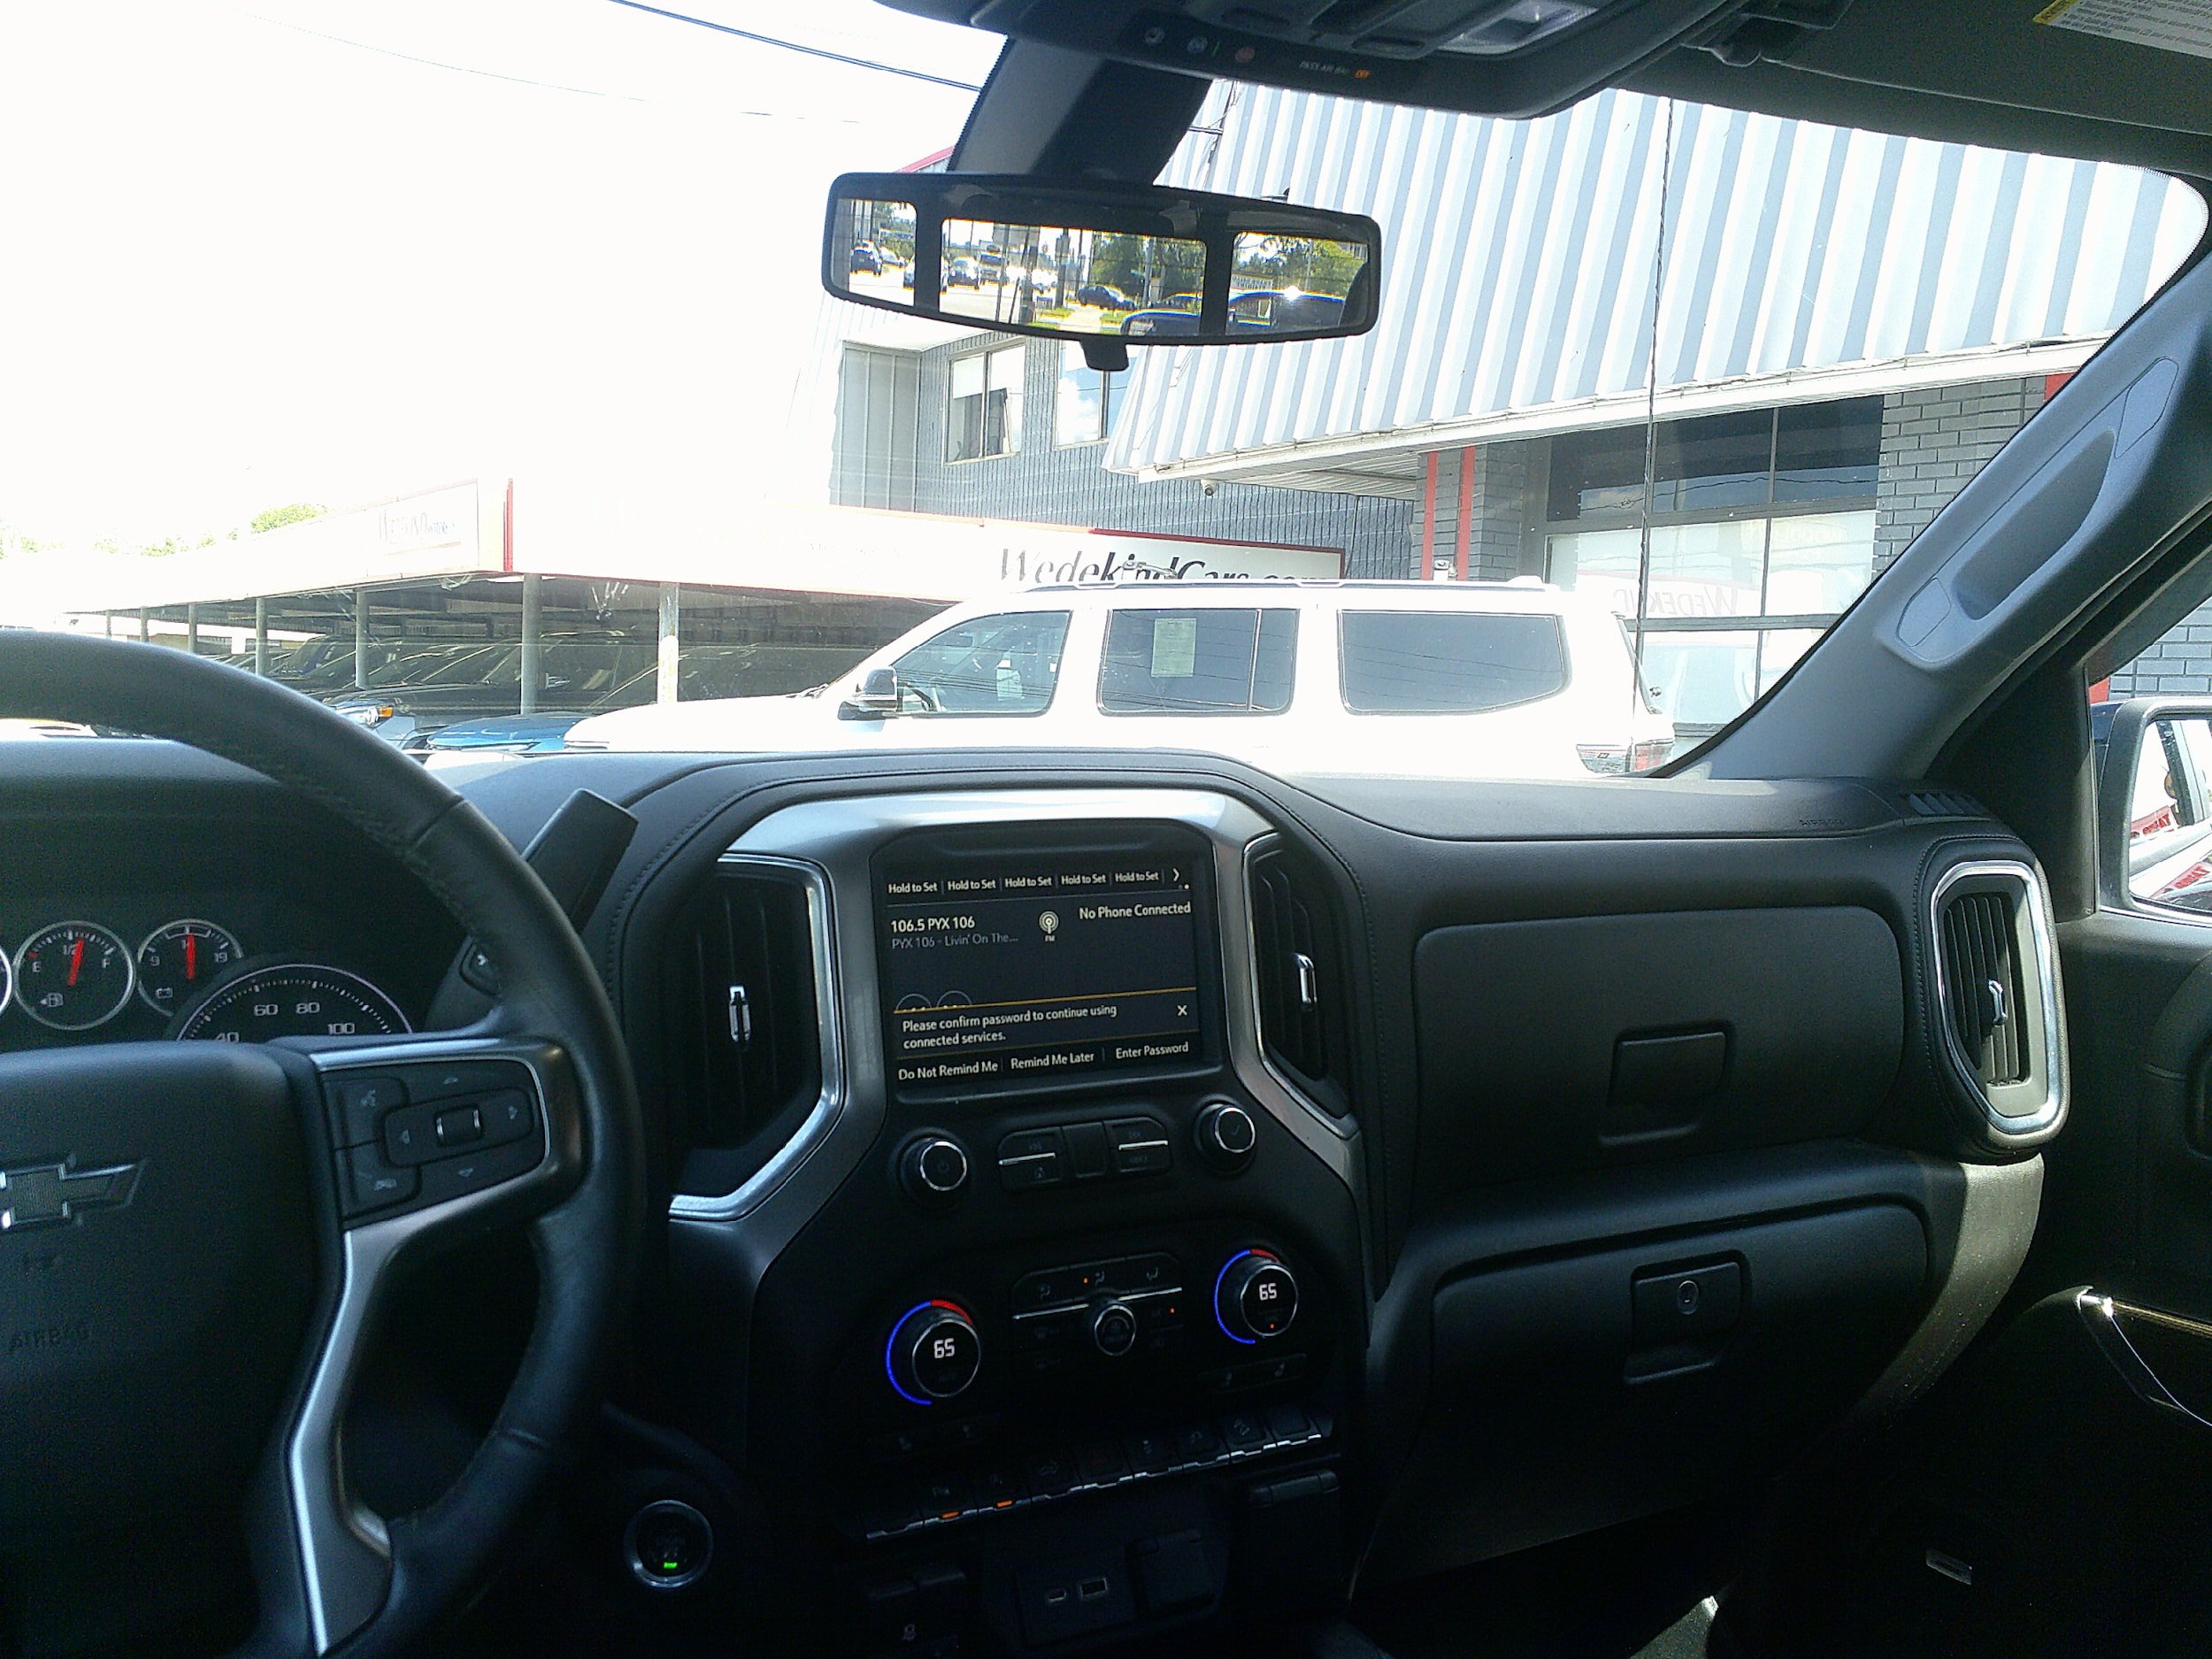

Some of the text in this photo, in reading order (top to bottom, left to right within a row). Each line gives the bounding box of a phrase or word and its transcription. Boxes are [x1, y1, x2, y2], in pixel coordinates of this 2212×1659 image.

[1005, 876, 1052, 887] Hold to Set
[1062, 874, 1081, 885] Hold
[1092, 873, 1106, 883] Set
[1115, 872, 1159, 882] Hold to Set
[888, 883, 910, 894] Hold
[923, 881, 938, 892] Set
[948, 879, 996, 891] Hold to Set
[1079, 902, 1192, 920] No Phone Connected
[891, 916, 975, 933] 106.5 PYX 106
[892, 938, 913, 949] PYX
[917, 936, 935, 948] 106
[972, 933, 988, 944] On
[32, 962, 42, 972] E
[102, 958, 111, 969] F
[253, 1003, 279, 1016] 60
[296, 1002, 320, 1014] 80
[902, 1004, 1118, 1033] Please confirm password to continue using
[327, 1022, 355, 1034] 100
[903, 1031, 1007, 1049] connected services.
[1115, 1041, 1190, 1060] Enter Password
[1010, 1052, 1094, 1070] Remind Me Later
[898, 1060, 999, 1080] Do Not Remind Me
[1259, 1282, 1278, 1302] 65
[933, 1338, 956, 1359] 65
